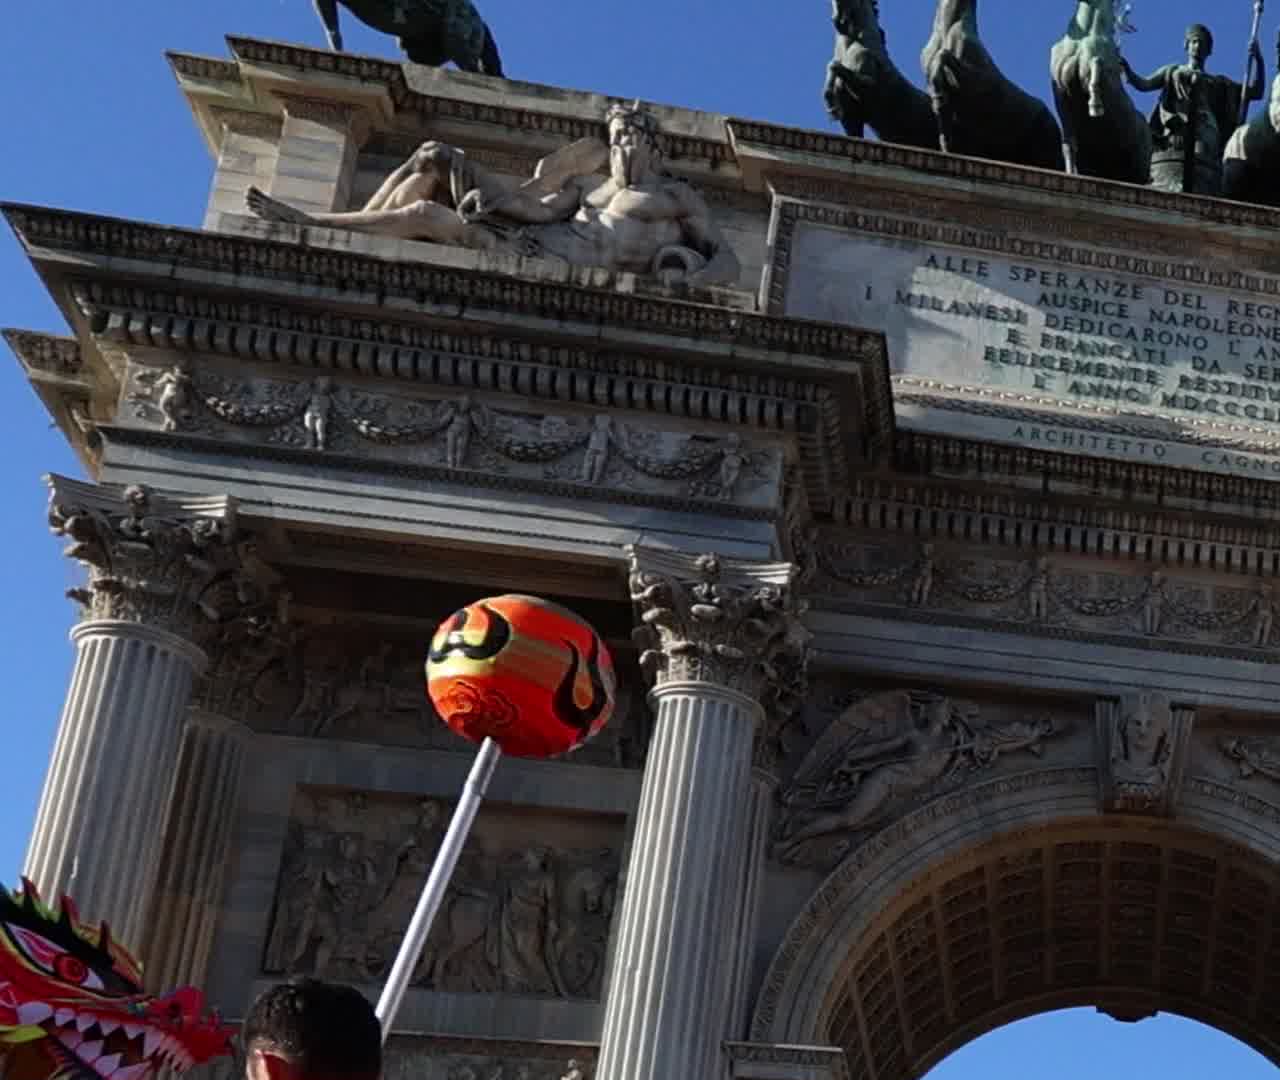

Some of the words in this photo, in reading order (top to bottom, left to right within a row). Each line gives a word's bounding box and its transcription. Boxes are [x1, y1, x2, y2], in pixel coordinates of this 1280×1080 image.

[926, 254, 990, 277] ALLE
[1008, 265, 1142, 299] SPERANZE
[1163, 289, 1208, 310] DEL
[864, 286, 873, 301] I
[896, 289, 1026, 325] MILANESI
[1045, 313, 1209, 351] DEDICARONO
[1036, 292, 1129, 318] AUSPICE
[983, 346, 1160, 385] FELICEMENTE
[1006, 328, 1021, 345] E
[1040, 332, 1168, 366] FRANCATI
[1191, 355, 1222, 374] DA
[1014, 425, 1167, 458] ARCHITETTO
